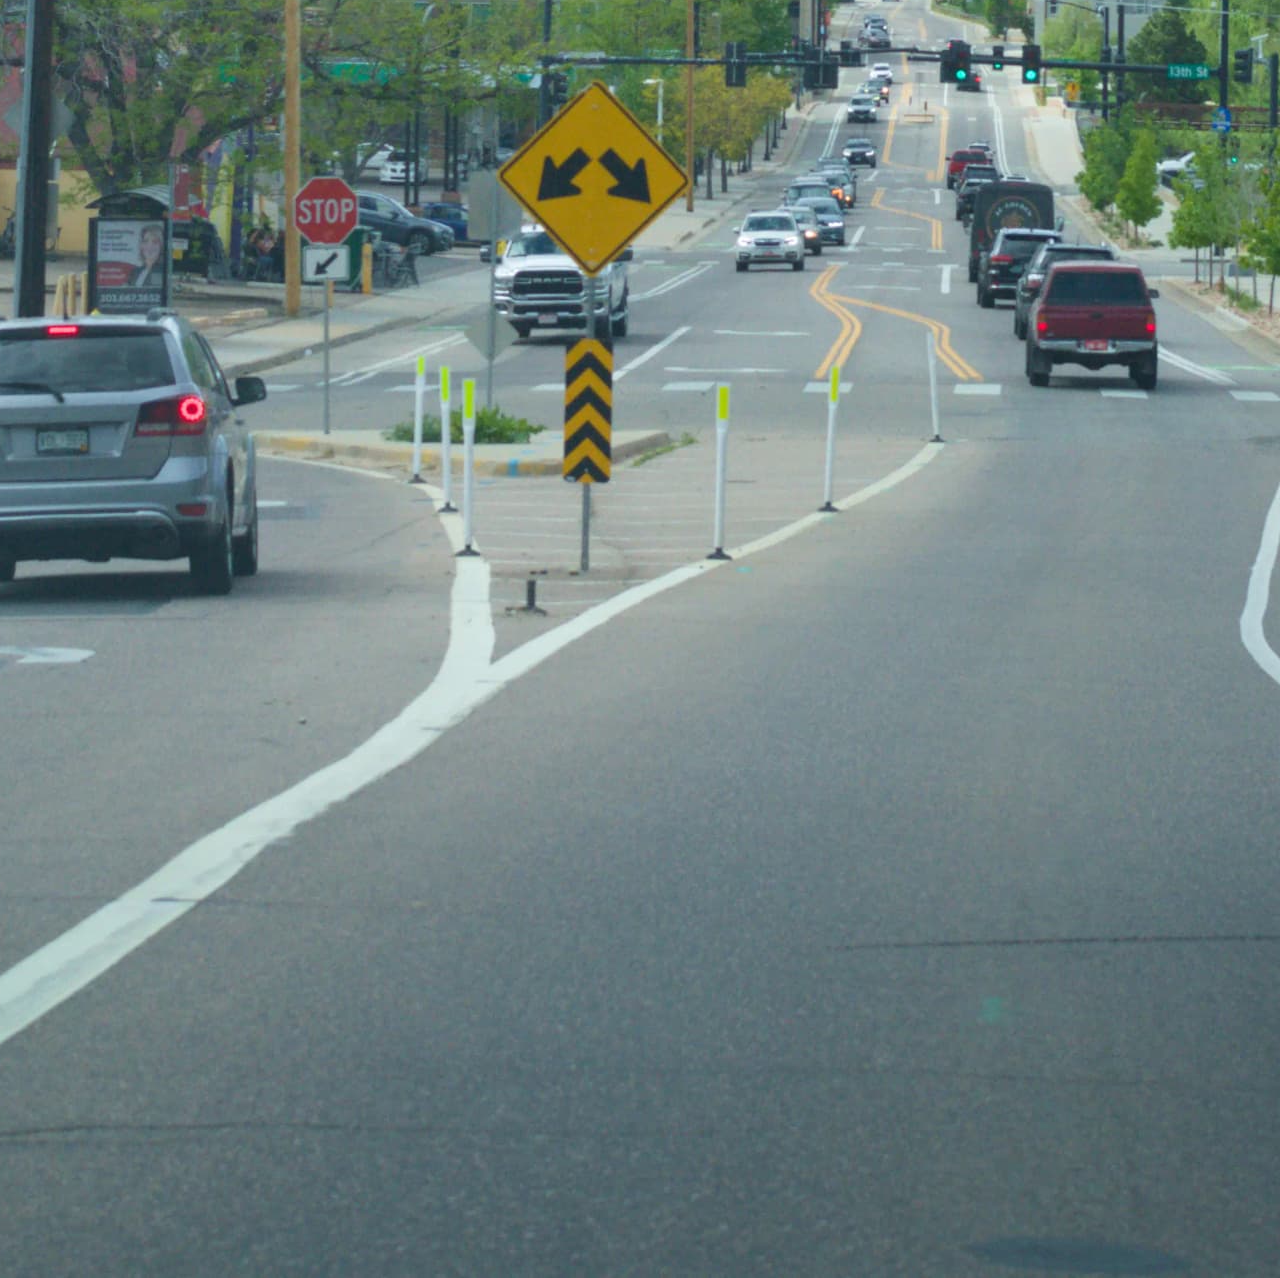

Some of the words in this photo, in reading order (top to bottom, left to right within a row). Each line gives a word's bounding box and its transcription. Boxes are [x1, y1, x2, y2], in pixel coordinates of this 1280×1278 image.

[1169, 66, 1192, 78] 13th
[1196, 66, 1209, 78] St
[298, 198, 354, 224] STOP
